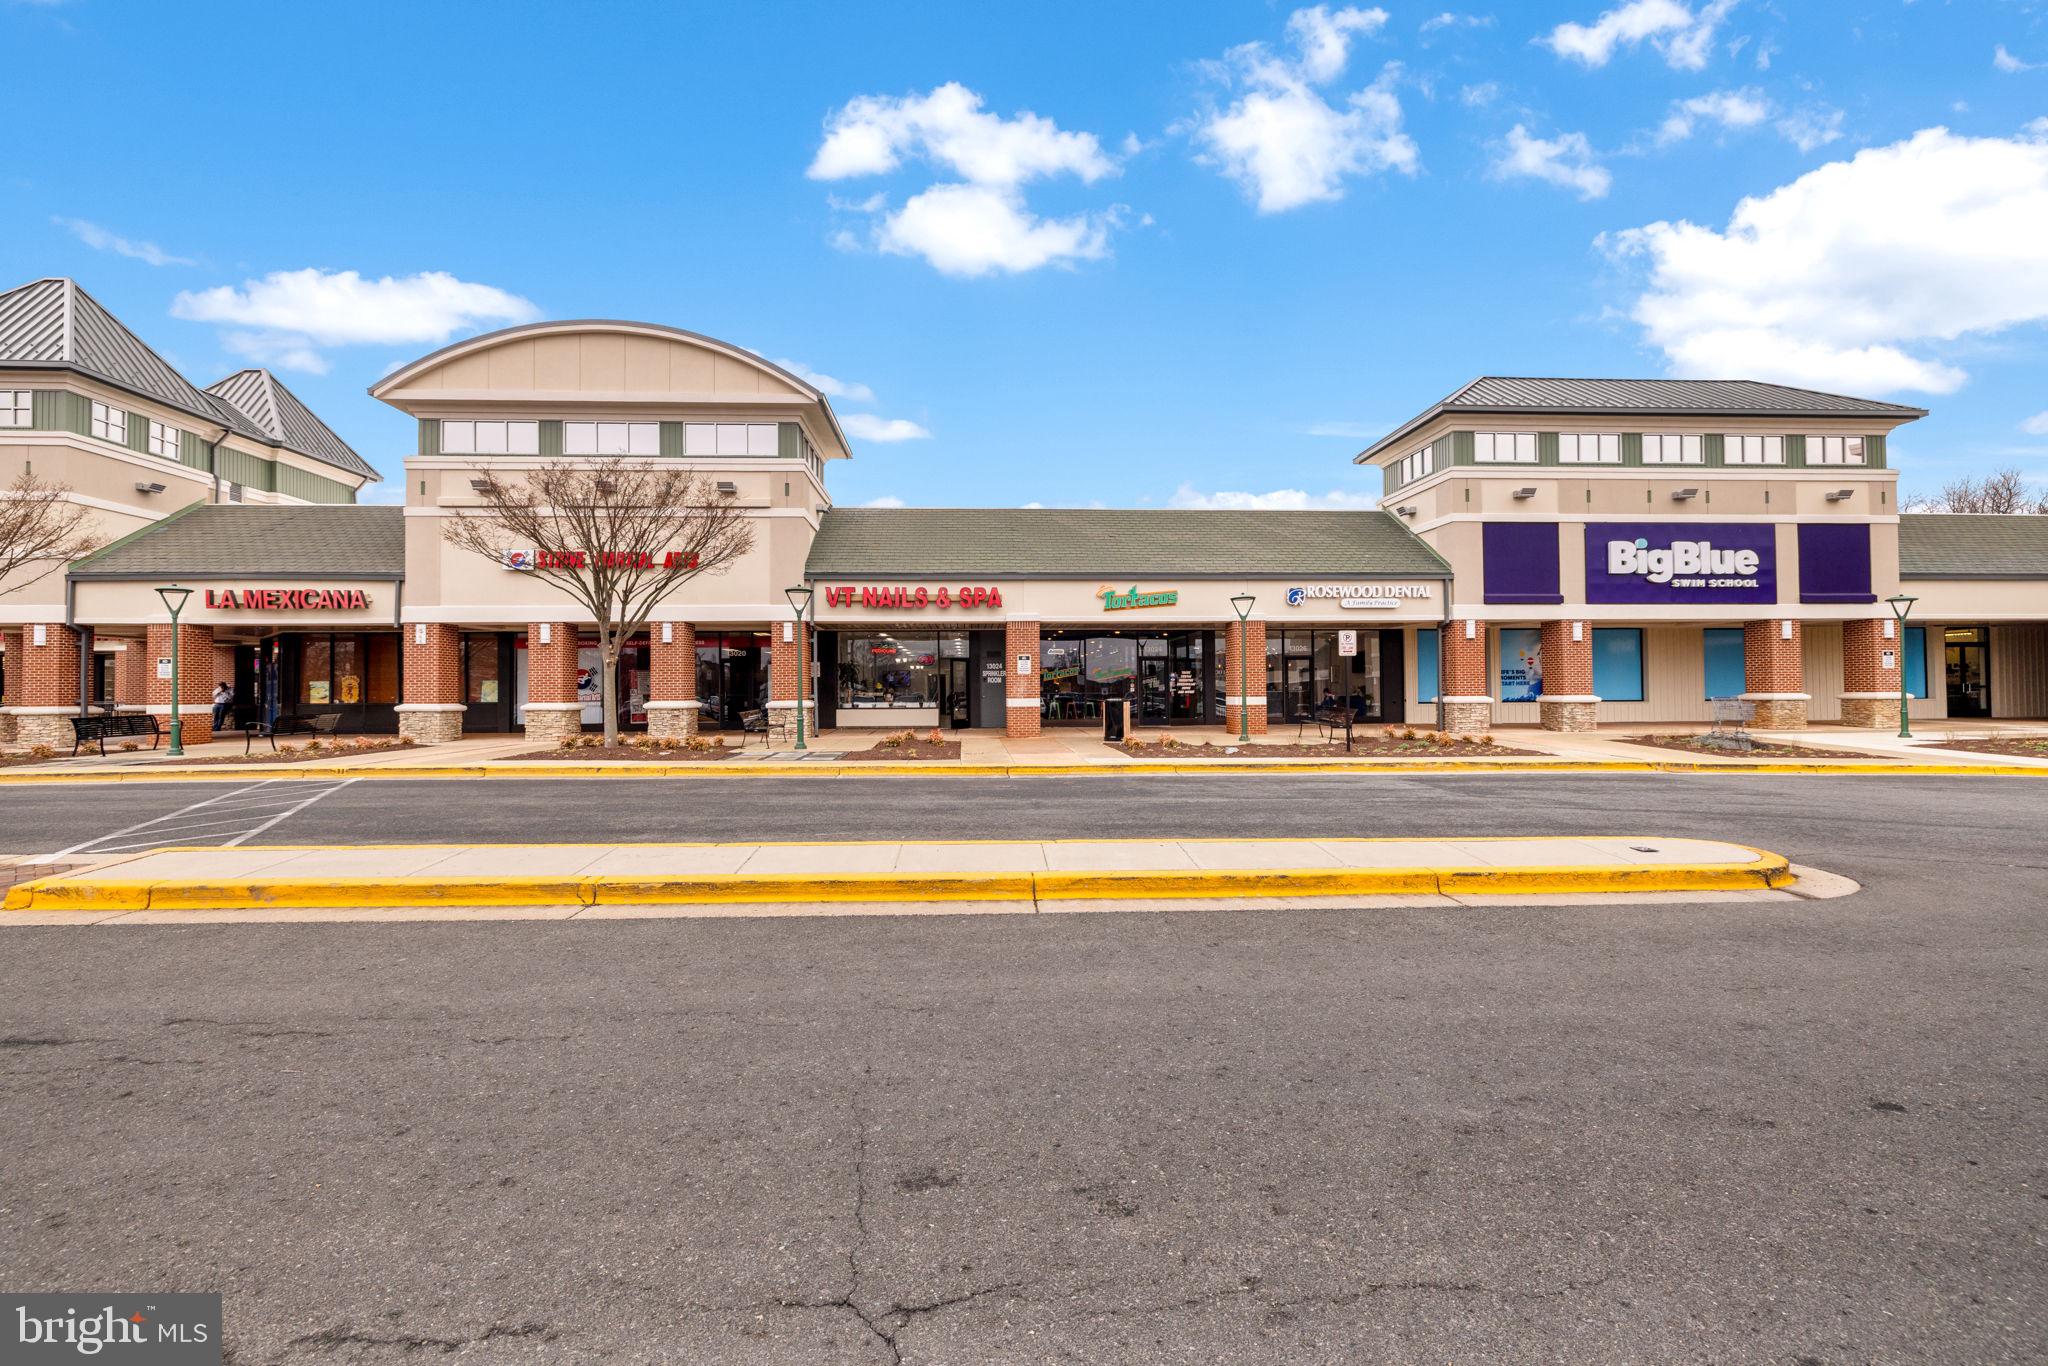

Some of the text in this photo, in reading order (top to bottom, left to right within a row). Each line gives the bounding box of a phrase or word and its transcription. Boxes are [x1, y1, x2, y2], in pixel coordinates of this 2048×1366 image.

[1608, 538, 1759, 583] BigBlue
[1307, 585, 1432, 598] ROSEWOOD DENTAL
[1671, 579, 1759, 587] SWIM SCHOOL
[205, 589, 368, 609] LA MEXICANA
[825, 586, 1002, 608] VT NAILS & SPA
[1104, 586, 1178, 609] Tortacos
